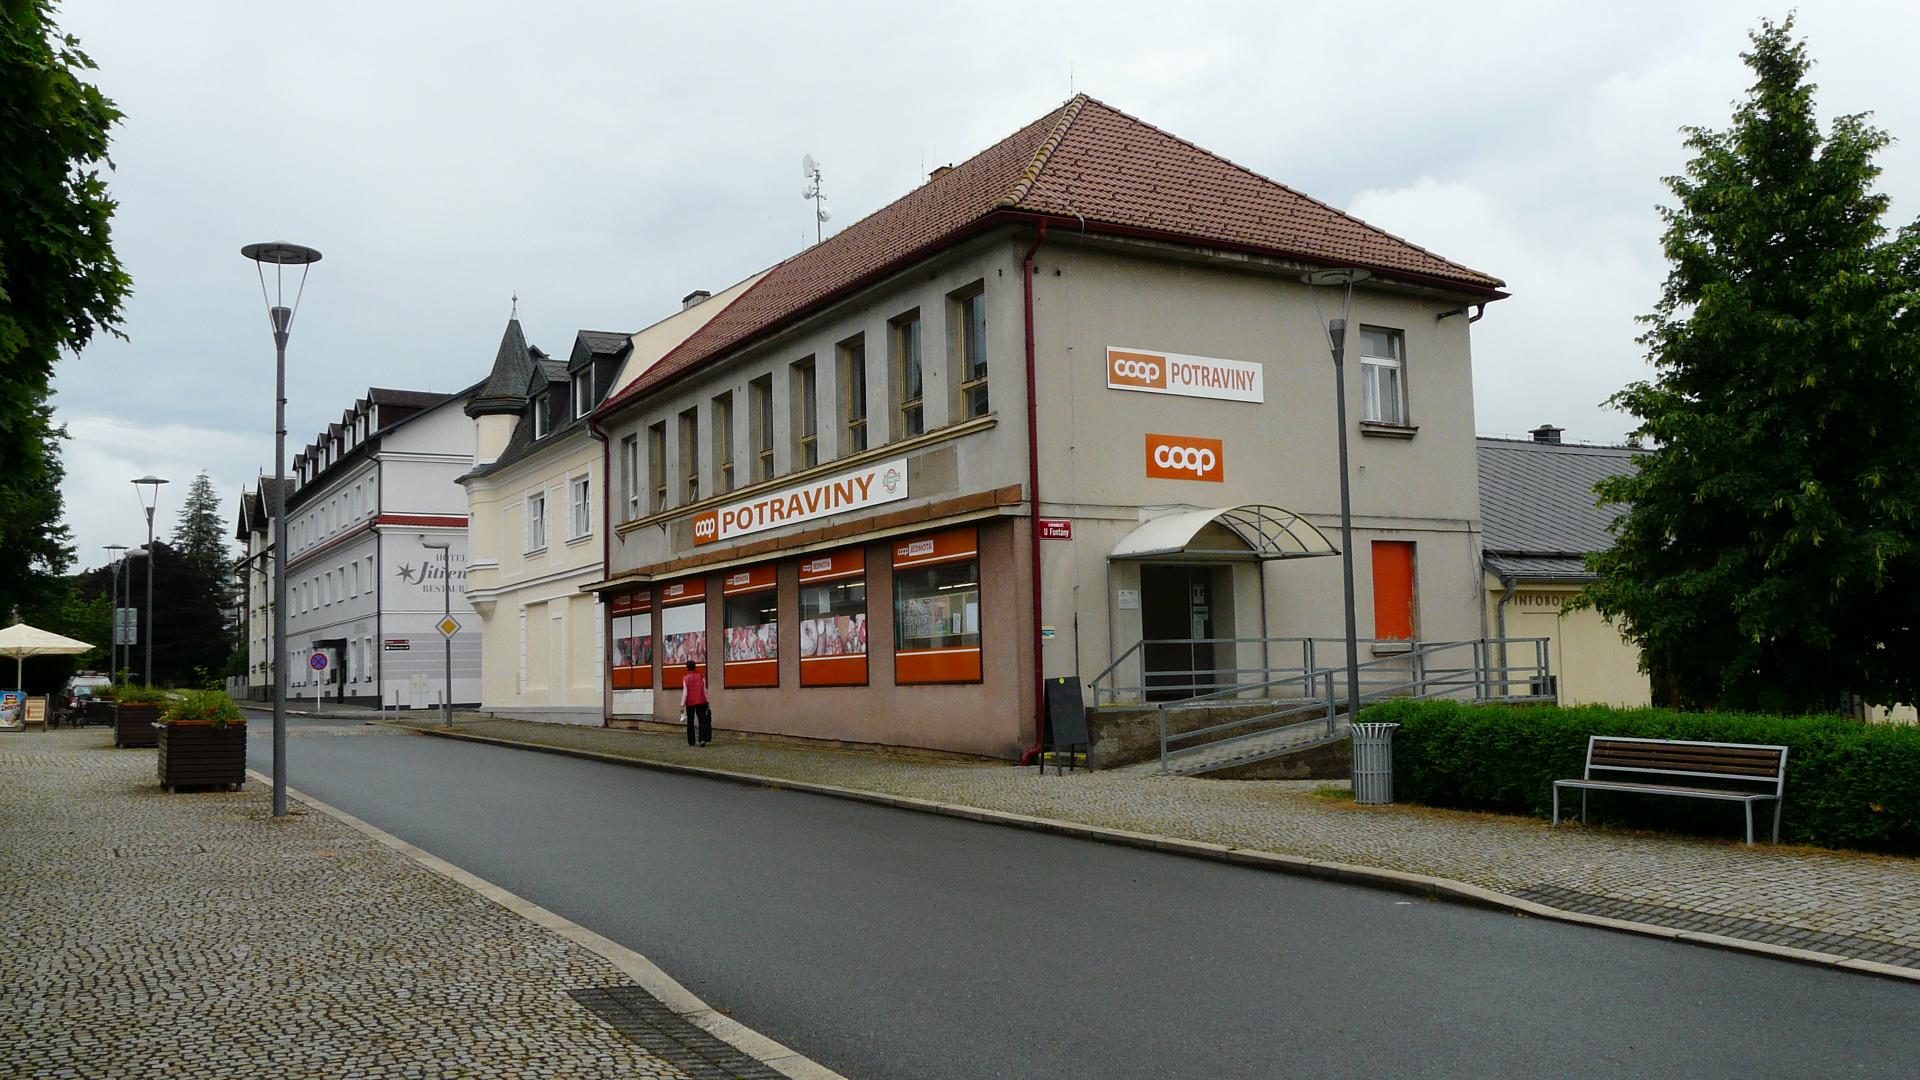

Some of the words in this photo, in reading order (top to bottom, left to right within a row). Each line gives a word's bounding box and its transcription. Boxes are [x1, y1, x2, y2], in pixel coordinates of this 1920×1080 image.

[1114, 359, 1160, 384] coop
[1171, 362, 1256, 391] POTRAVINY
[1154, 445, 1216, 476] coop
[695, 517, 716, 538] coop
[722, 472, 876, 534] POTRAVINY
[1043, 527, 1049, 536] U
